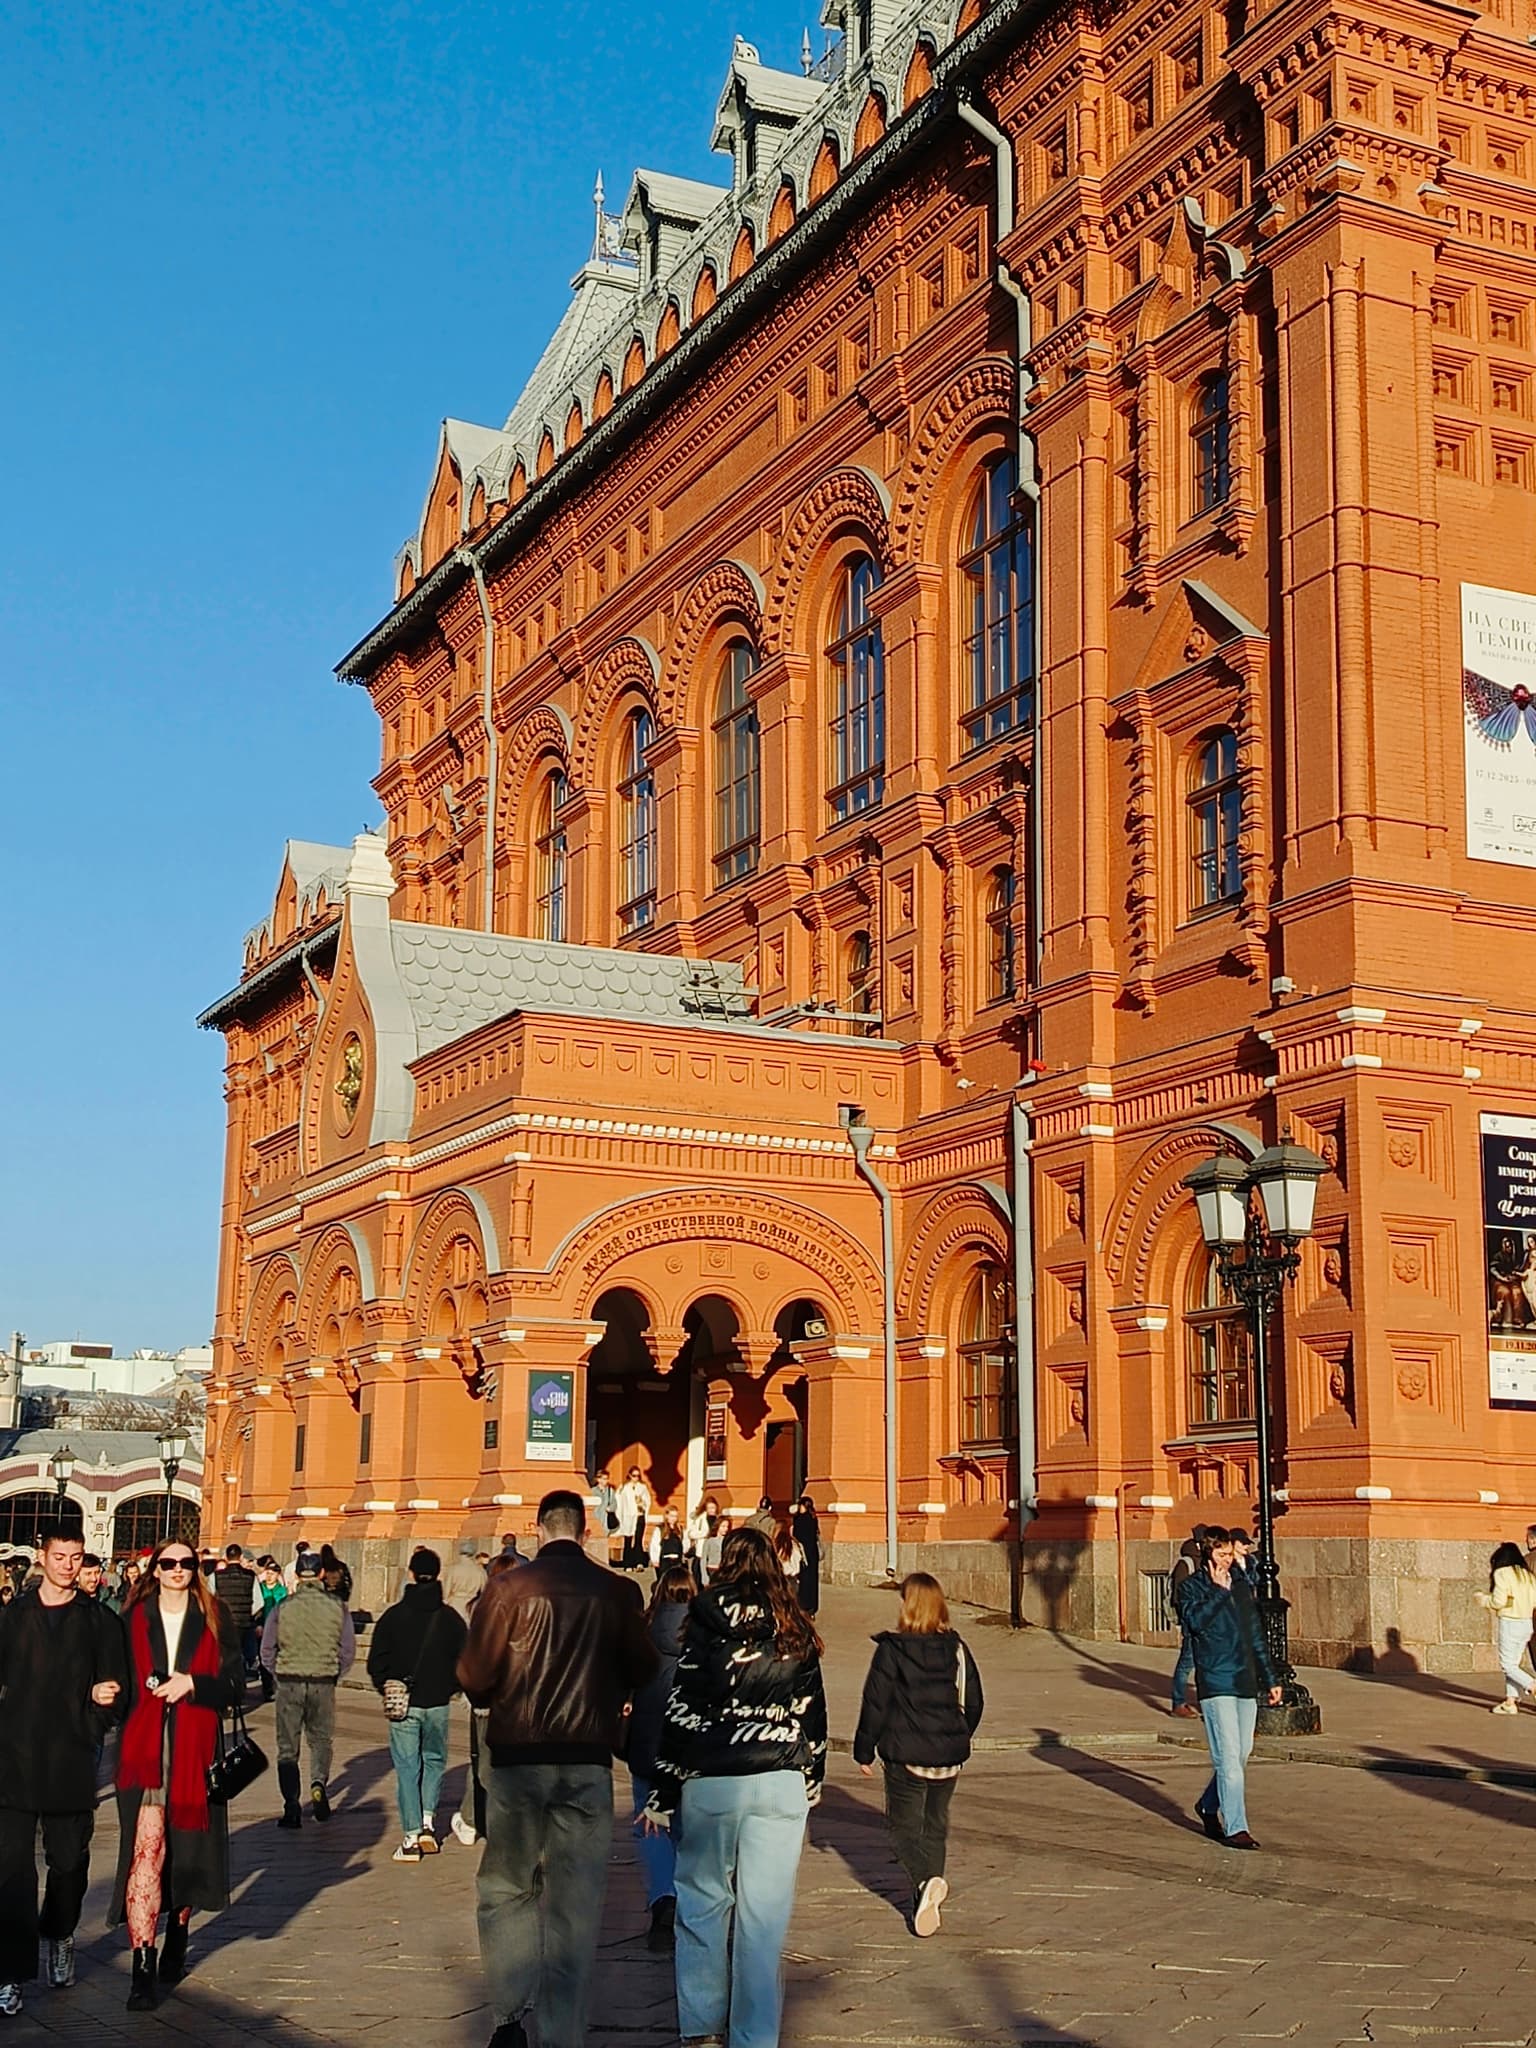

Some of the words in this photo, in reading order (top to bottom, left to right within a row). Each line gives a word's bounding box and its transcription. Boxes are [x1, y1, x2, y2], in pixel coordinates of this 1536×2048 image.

[1468, 610, 1491, 627] НА
[1498, 616, 1536, 635] СВЕ
[582, 1235, 622, 1276] МУЗЕЙ
[626, 1214, 744, 1240] ОТЕЧЕСТВЕННОЙ
[750, 1219, 800, 1245] ВОЙНЫ
[802, 1240, 829, 1263] 1812
[828, 1257, 857, 1291] ГОДА
